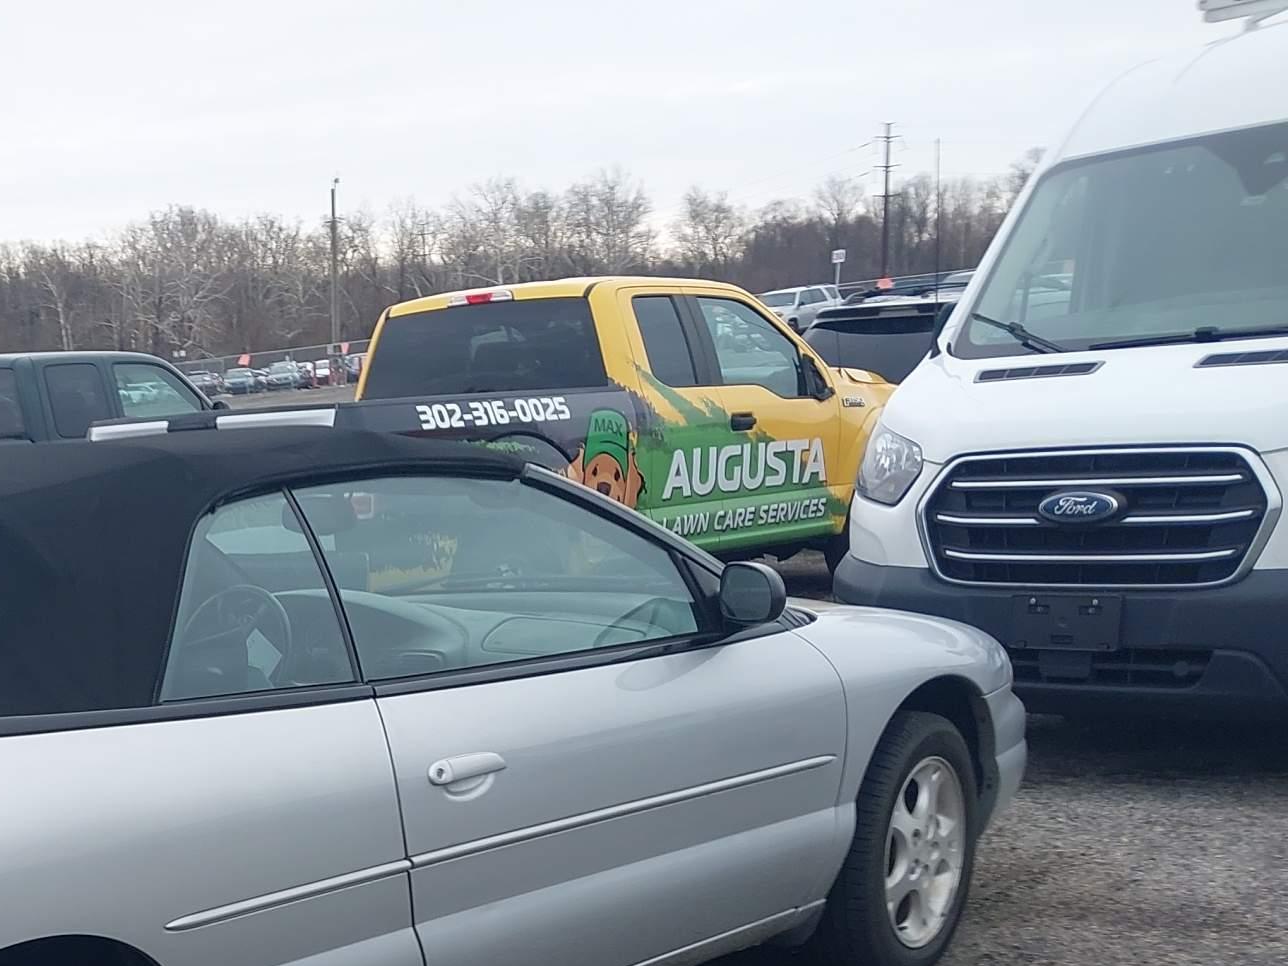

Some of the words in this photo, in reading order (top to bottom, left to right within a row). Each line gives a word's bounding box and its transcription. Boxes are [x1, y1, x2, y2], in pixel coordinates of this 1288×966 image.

[415, 397, 571, 430] 302-316-0025
[594, 418, 624, 436] MAX
[662, 437, 827, 500] AUGUSTA
[714, 506, 757, 531] CARE
[757, 497, 827, 525] SERVICES
[1054, 497, 1098, 515] Ford
